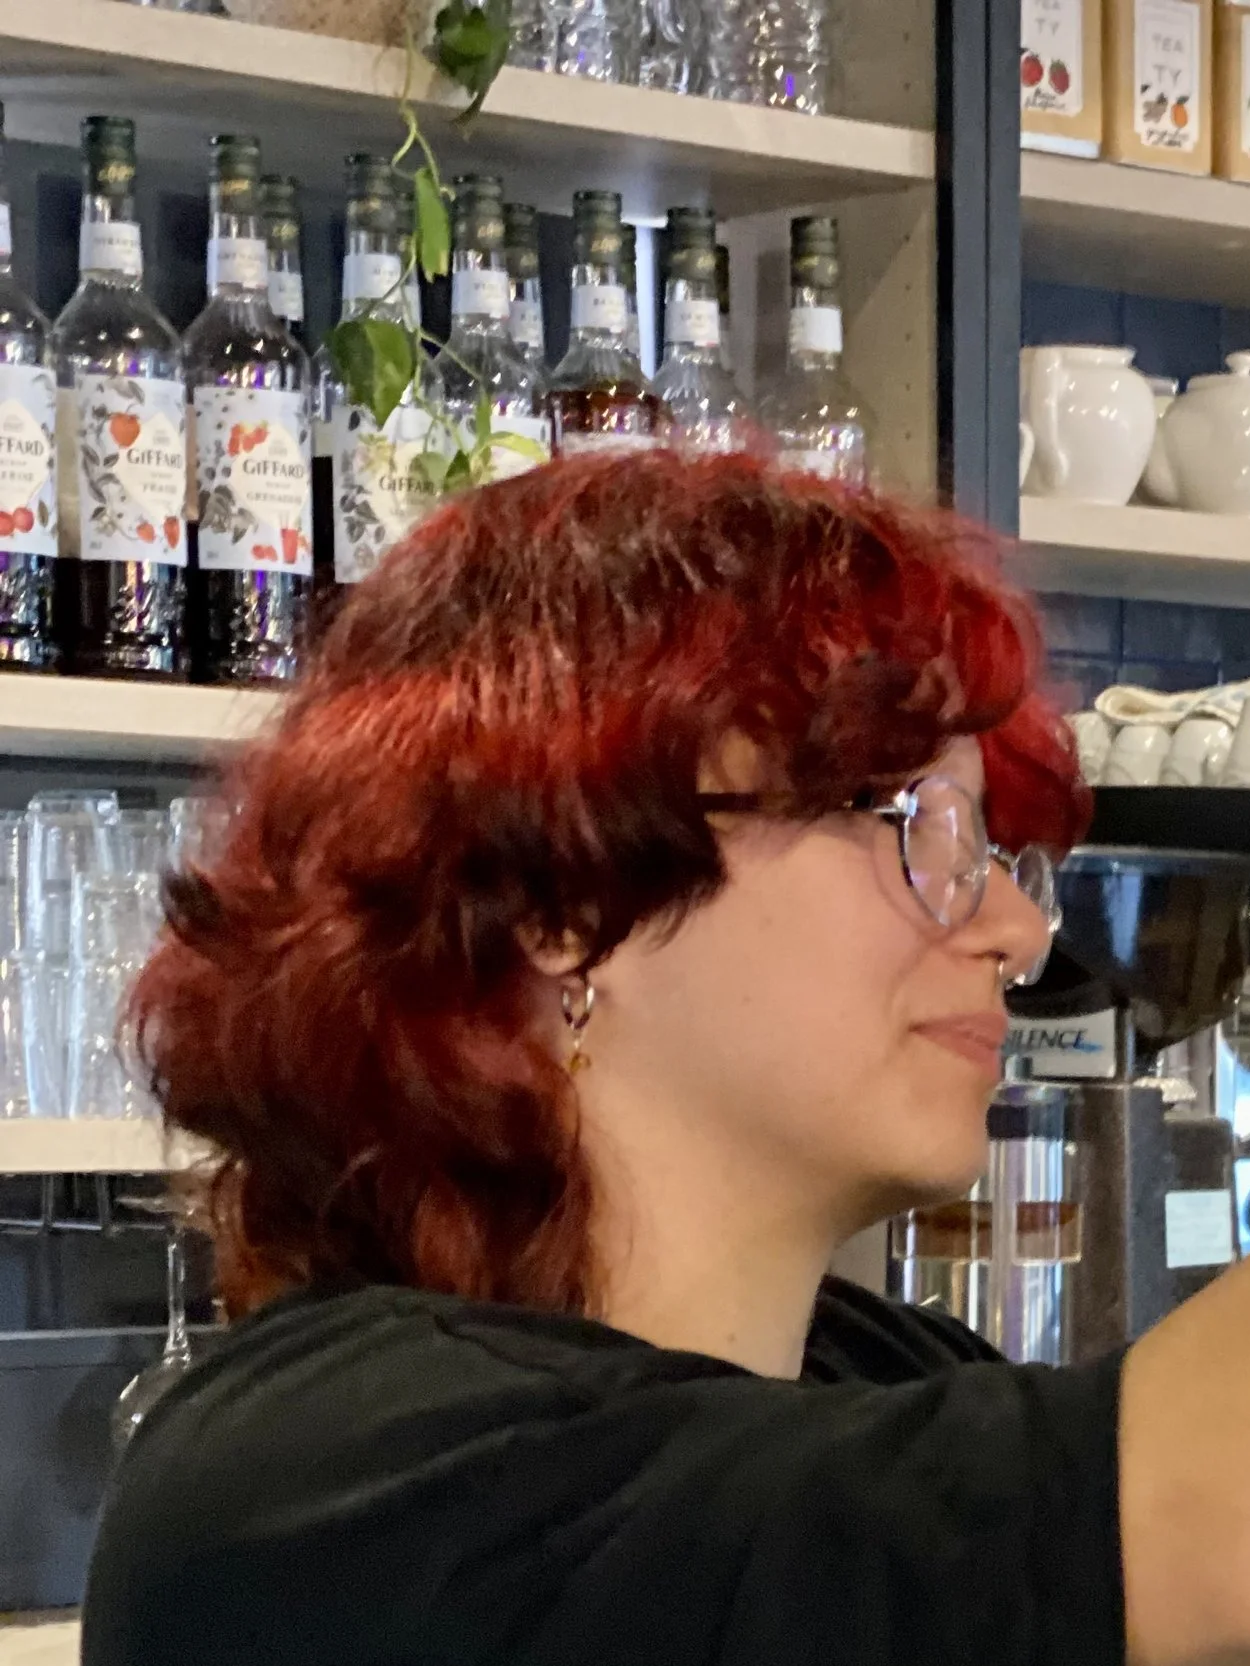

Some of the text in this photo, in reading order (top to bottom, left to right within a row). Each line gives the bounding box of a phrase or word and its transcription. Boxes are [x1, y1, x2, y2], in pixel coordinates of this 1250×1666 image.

[1152, 33, 1184, 52] TEA
[1152, 64, 1183, 86] TY
[127, 449, 183, 469] GIFFARD
[243, 459, 305, 479] GIFFARD
